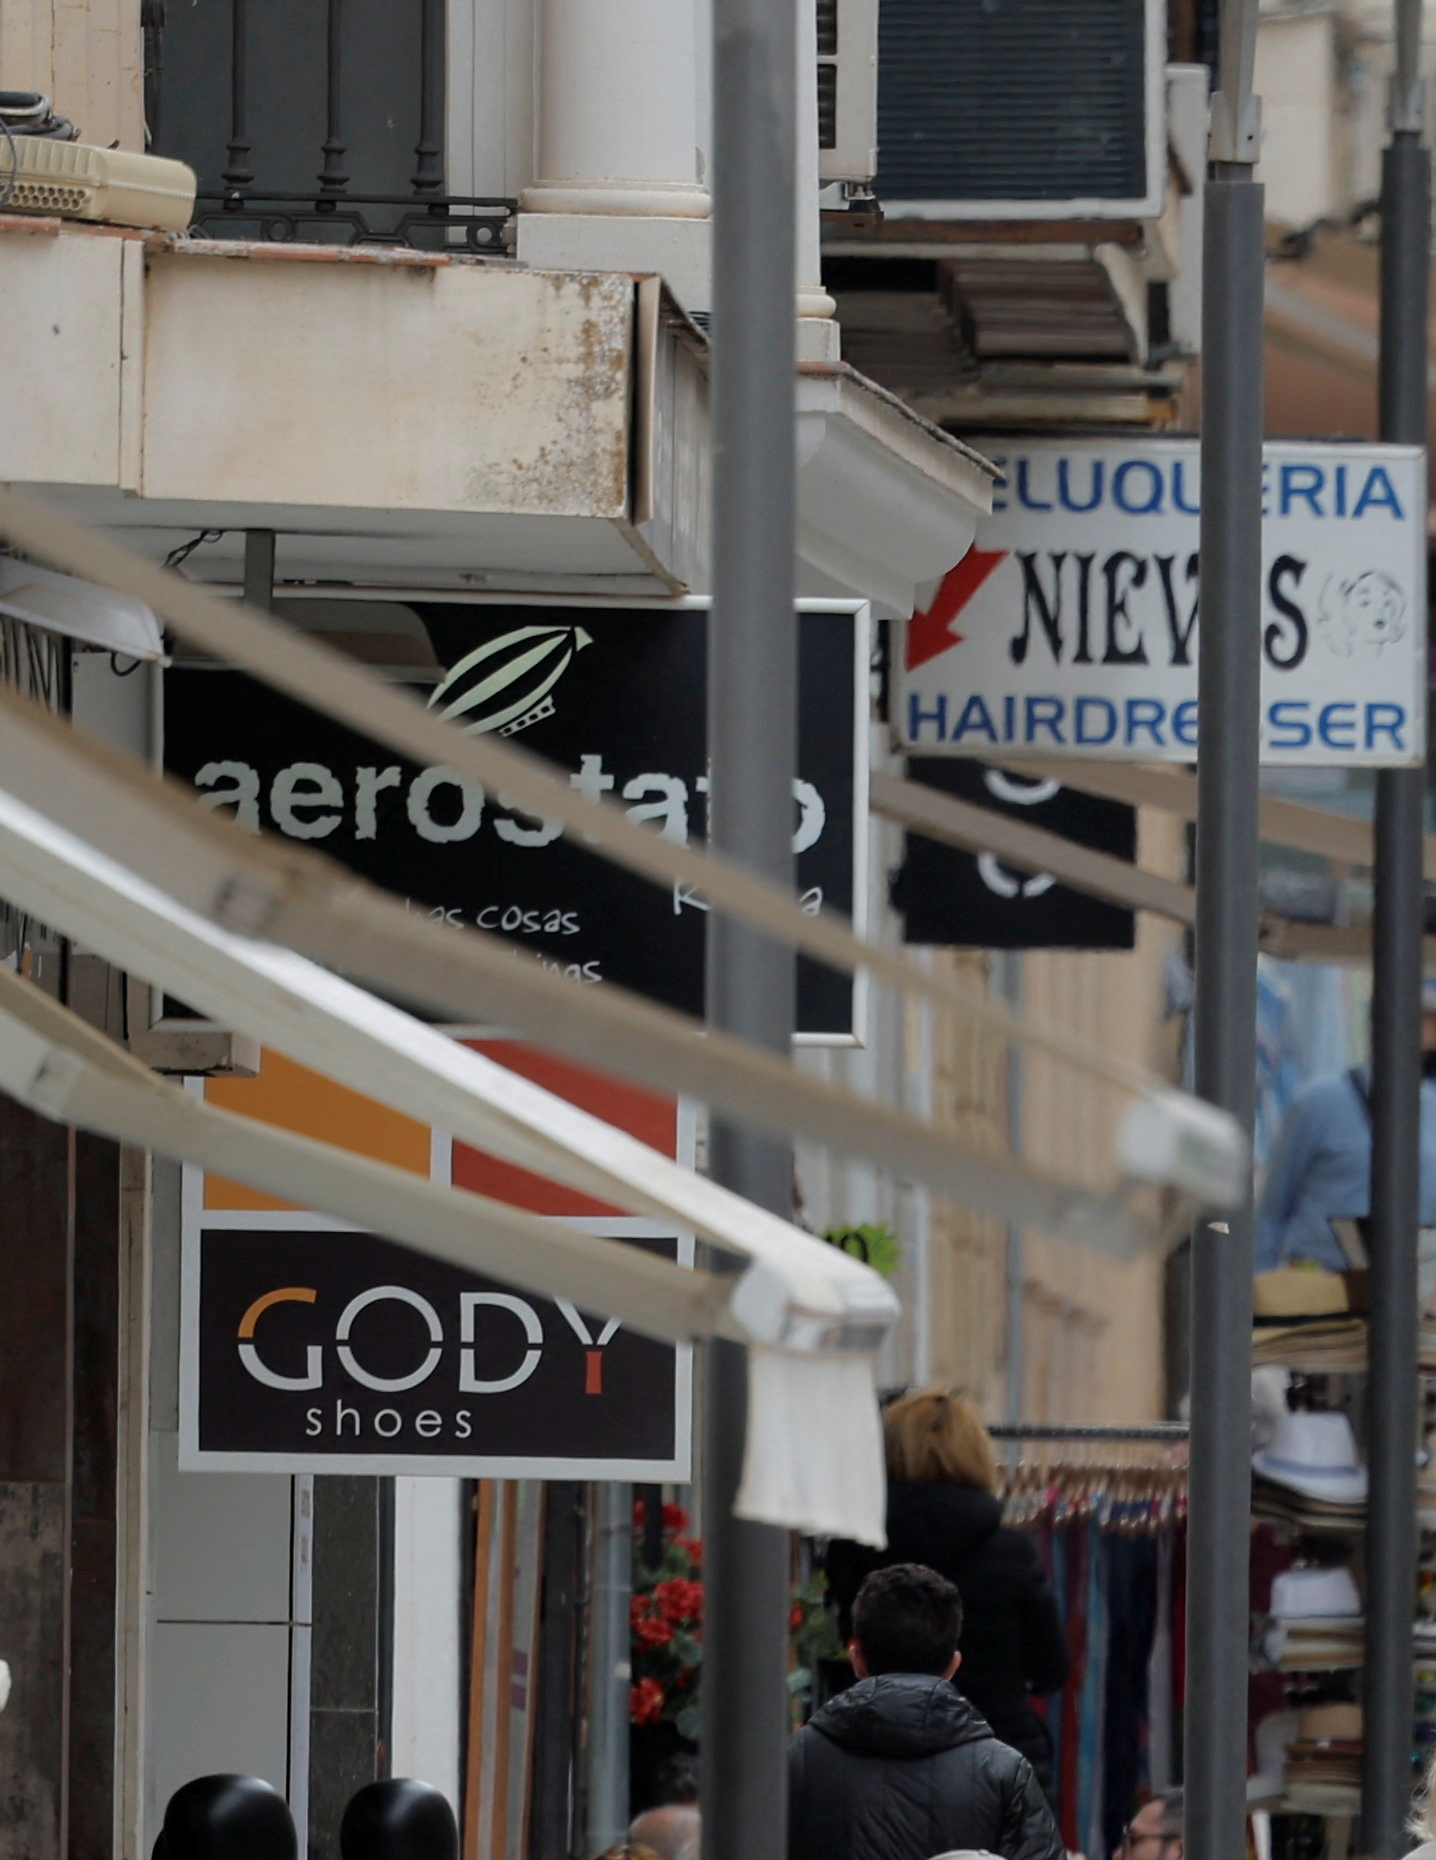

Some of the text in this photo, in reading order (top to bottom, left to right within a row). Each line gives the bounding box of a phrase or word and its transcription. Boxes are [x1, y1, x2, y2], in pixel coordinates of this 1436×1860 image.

[1010, 549, 1308, 671] NIEVS
[906, 694, 1407, 752] HAIRDRESER
[476, 905, 581, 935] cosas
[237, 1284, 622, 1395] GODY
[304, 1398, 474, 1440] shoes
